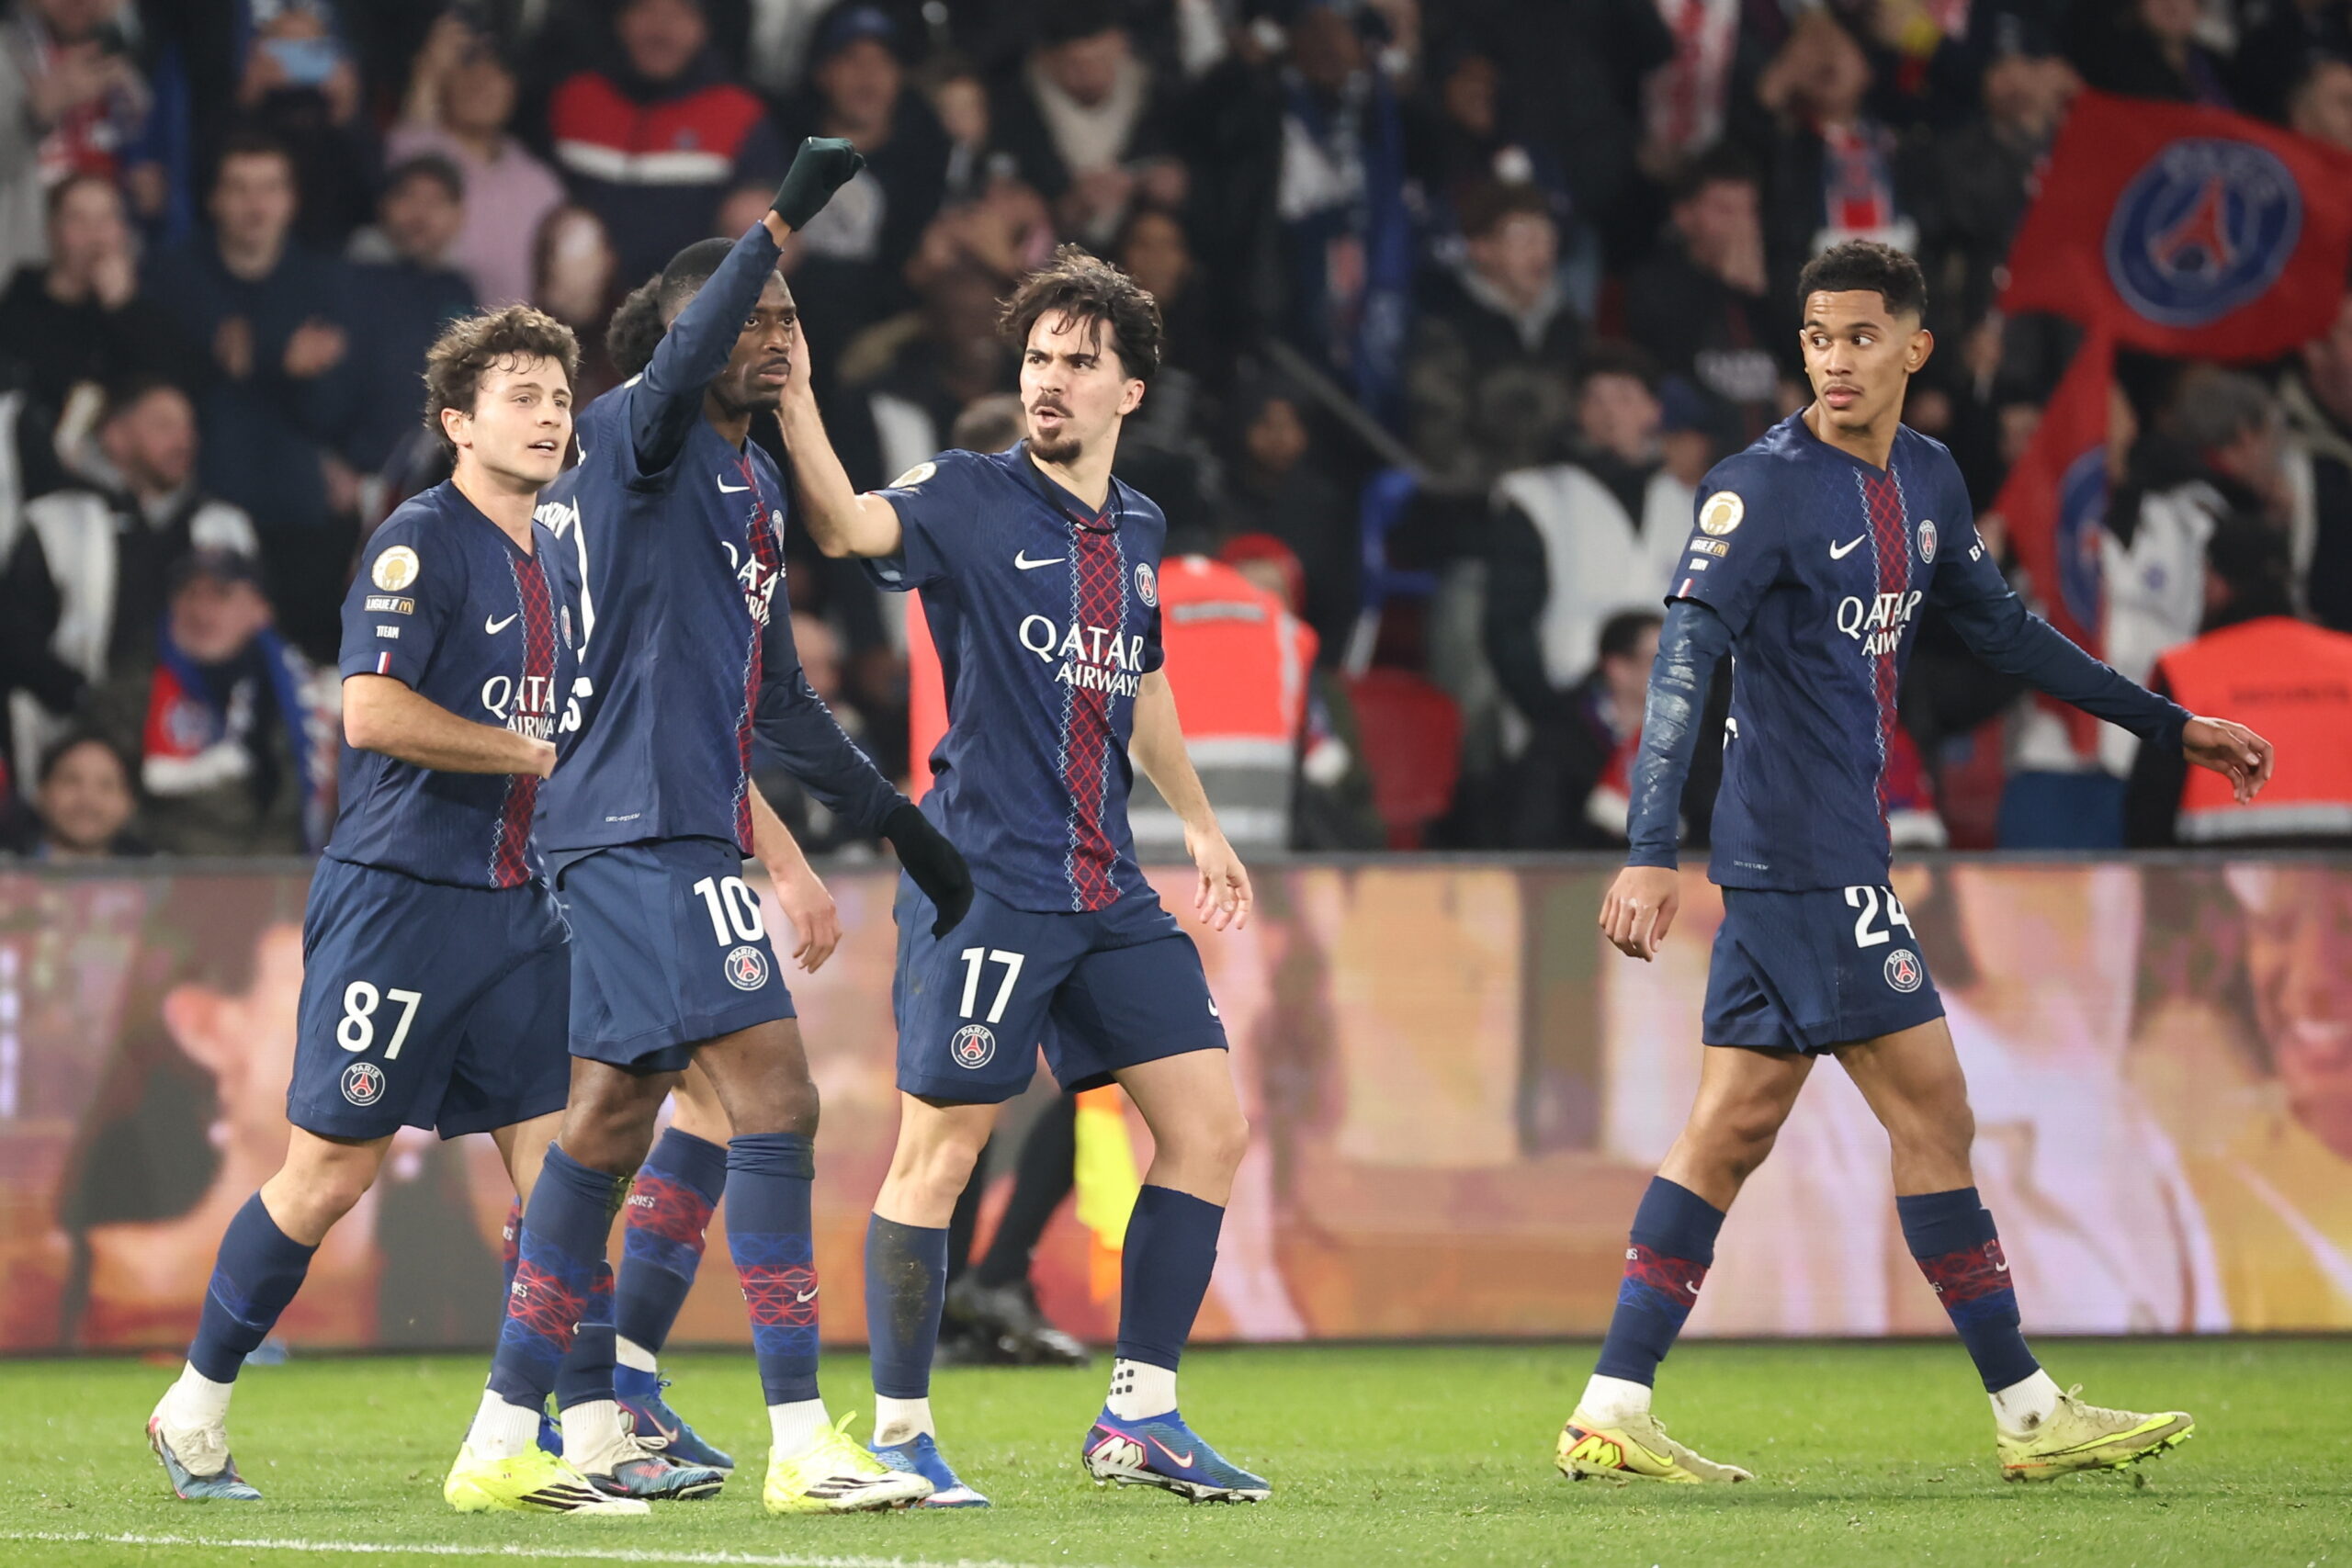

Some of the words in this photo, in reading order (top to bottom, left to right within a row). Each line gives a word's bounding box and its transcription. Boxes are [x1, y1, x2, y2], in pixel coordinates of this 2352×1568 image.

[1837, 590, 1923, 640] QATAR
[1019, 614, 1144, 672] QATAR
[481, 675, 556, 720] QATA
[1055, 661, 1139, 698] AIRWAYS
[693, 874, 766, 947] 10
[1844, 886, 1917, 949] 24
[729, 948, 757, 963] PARIS
[1888, 951, 1914, 964] PARIS
[958, 946, 1025, 1024] 17
[335, 980, 423, 1061] 87
[961, 1026, 990, 1040] PARIS
[351, 1065, 380, 1078] PARIS
